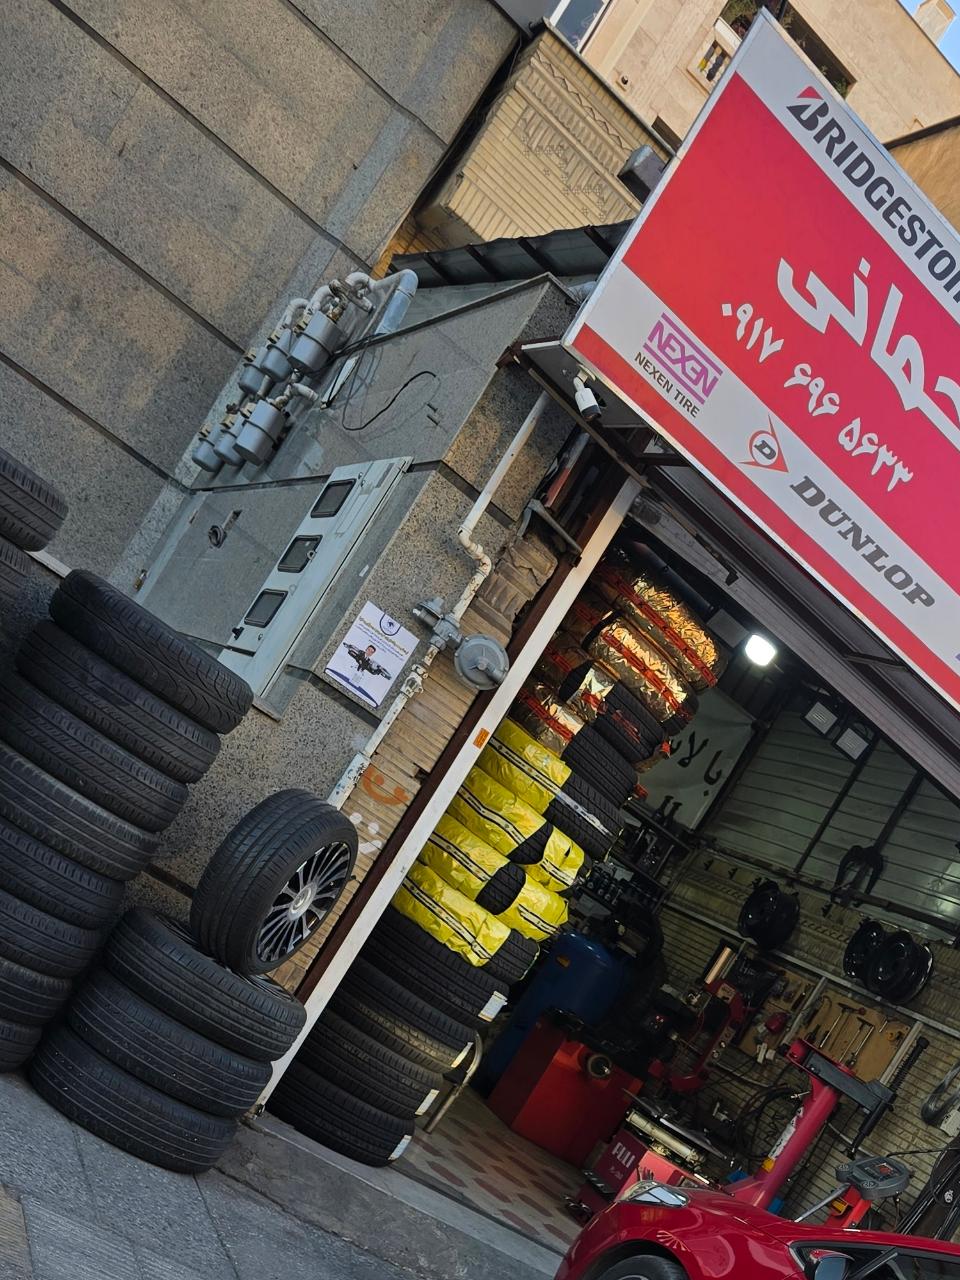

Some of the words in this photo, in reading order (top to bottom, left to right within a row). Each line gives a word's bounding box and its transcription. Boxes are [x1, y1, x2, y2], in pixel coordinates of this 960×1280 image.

[634, 351, 675, 394] NEXEN
[674, 388, 701, 418] TIRE
[721, 302, 785, 363] ۰۹۱۷
[784, 363, 840, 419] ۶۹۶
[837, 416, 914, 493] ۵۶۳۳
[790, 475, 935, 608] DUNLOP
